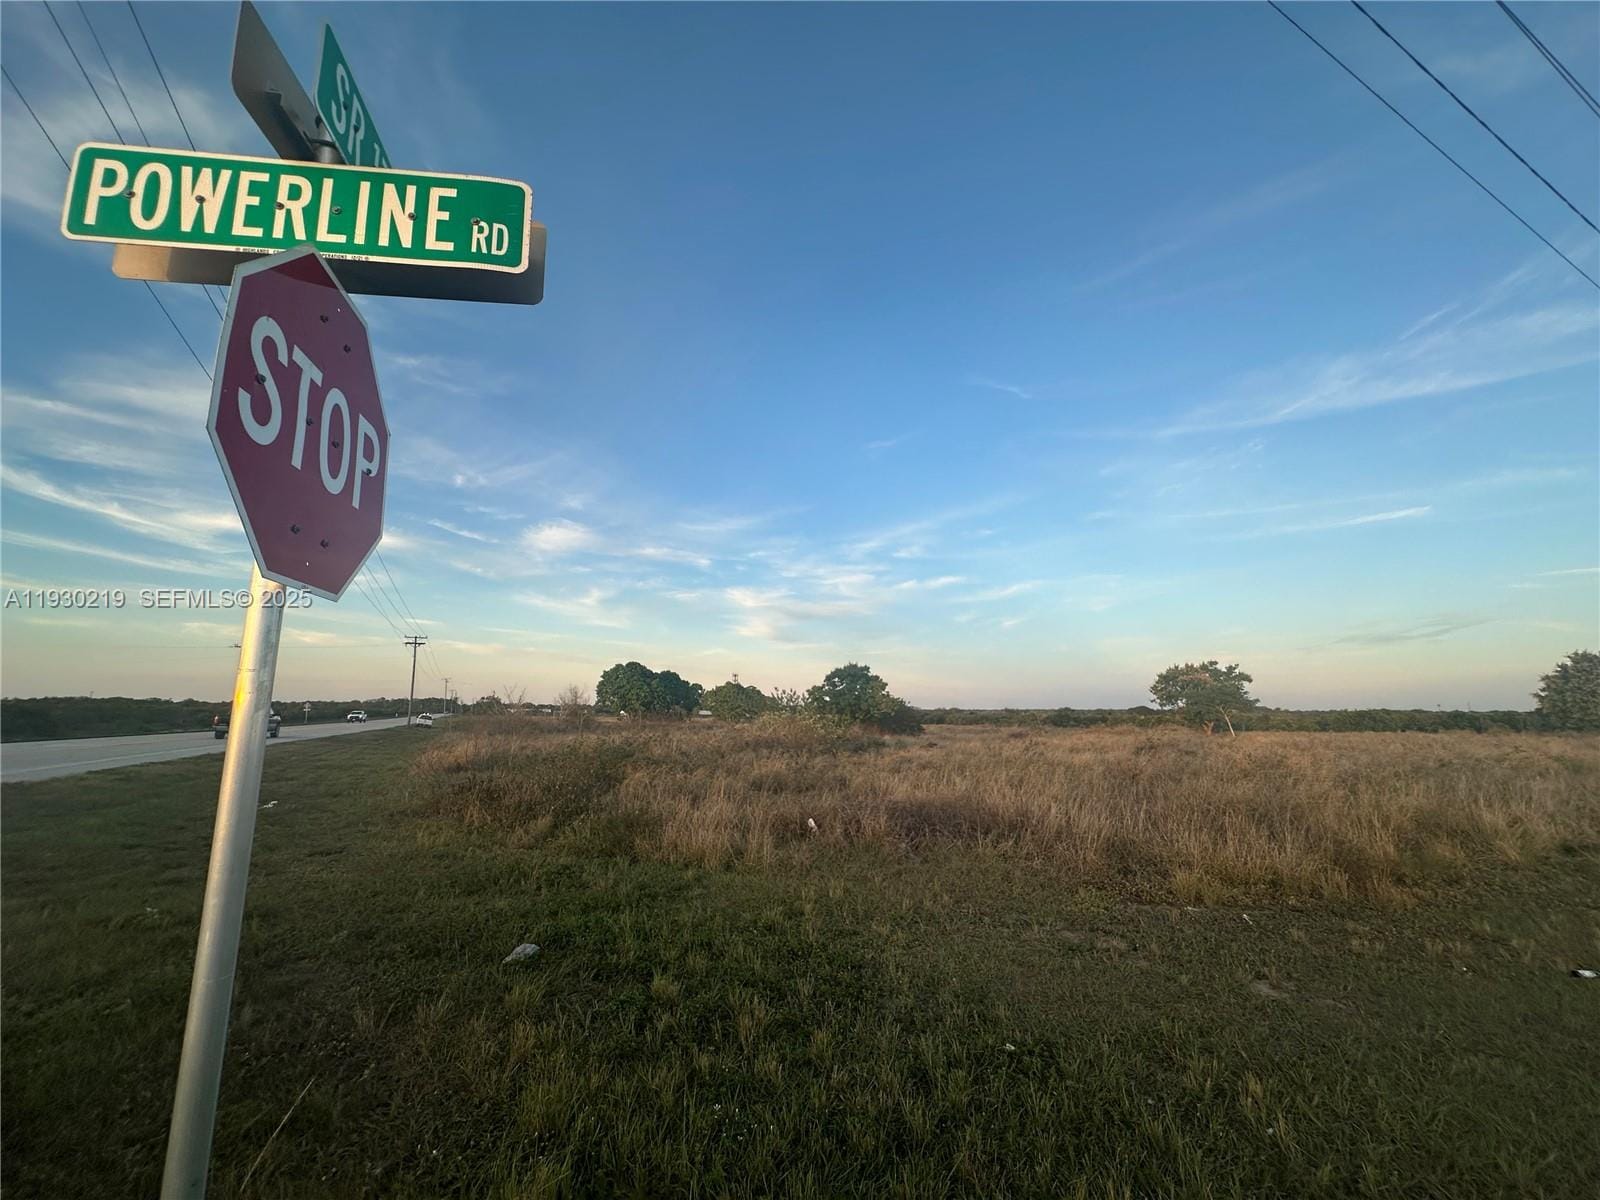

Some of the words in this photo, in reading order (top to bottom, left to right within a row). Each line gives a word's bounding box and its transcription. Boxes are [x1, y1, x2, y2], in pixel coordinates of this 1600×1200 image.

[331, 63, 366, 166] SR
[83, 157, 458, 251] POWERLINE
[470, 218, 509, 256] RD
[237, 315, 381, 510] STOP
